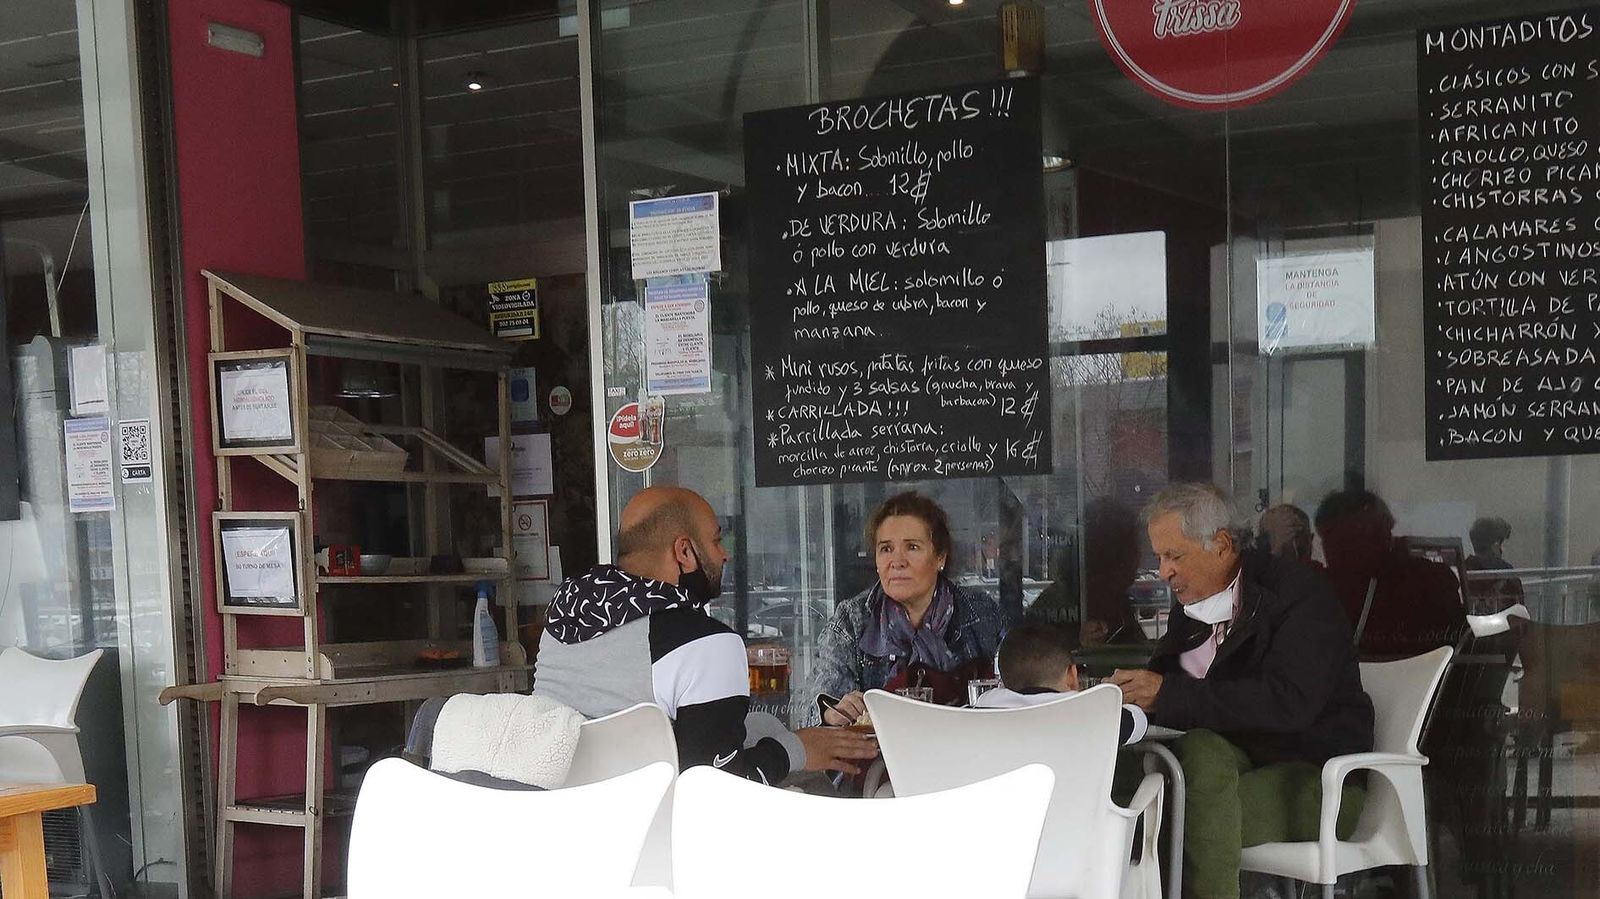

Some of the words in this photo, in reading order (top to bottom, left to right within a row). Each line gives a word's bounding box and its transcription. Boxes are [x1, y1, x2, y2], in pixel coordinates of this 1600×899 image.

[1425, 13, 1593, 55] MONTADITOS
[1439, 63, 1531, 93] CLÁSICOS
[1541, 62, 1576, 80] CON
[808, 90, 980, 135] BROCHETAS
[1439, 90, 1573, 121] SERRANITO
[1438, 116, 1579, 143] AFRICANITO
[786, 149, 850, 176] MIXTA:
[1533, 140, 1588, 161] QUESO
[1441, 167, 1531, 190] CHORIZO
[797, 187, 806, 204] y
[1442, 187, 1583, 209] CHISTORRAS
[789, 220, 812, 239] DE
[1443, 218, 1576, 243] CALAMARES
[810, 240, 845, 267] pollo
[851, 242, 876, 257] con
[886, 238, 951, 257] verdura
[814, 273, 836, 297] LA
[904, 267, 985, 290] solomillo
[1285, 268, 1339, 280] MANTENGA
[1297, 280, 1340, 290] DISTANCIA
[1444, 268, 1499, 292] ATÚN
[1508, 269, 1545, 287] CON
[505, 294, 521, 302] ZONA
[828, 298, 868, 320] queso
[872, 299, 885, 312] de
[936, 292, 969, 310] bacon
[976, 299, 987, 314] y
[1289, 300, 1336, 310] SEGURIDAD
[1445, 295, 1537, 318] TORTILLA
[1549, 296, 1575, 314] DE
[1445, 316, 1577, 344] CHICHARRÓN
[867, 353, 914, 382] patatas
[921, 355, 961, 378] fritas
[967, 357, 992, 371] con
[998, 356, 1043, 378] queso
[1447, 347, 1596, 368] SOBREASADA
[785, 380, 831, 402] fundido
[838, 383, 848, 406] y
[853, 380, 863, 394] 3
[869, 377, 920, 394] salsas
[985, 378, 1017, 392] brava
[1025, 380, 1034, 393] y
[1447, 376, 1487, 396] PAN
[1503, 376, 1524, 393] DE
[778, 399, 883, 420] CARRILLADA
[1001, 396, 1016, 416] 12
[1448, 395, 1517, 419] JAMÓN
[779, 415, 862, 445] Parrillada
[1449, 427, 1523, 445] BACON
[1543, 427, 1555, 442] Y
[623, 450, 639, 458] zero
[639, 449, 655, 457] zero
[778, 444, 828, 466] morcilla
[833, 442, 845, 459] de
[941, 435, 982, 453] criollo
[989, 442, 999, 455] y
[793, 463, 835, 479] chorizo
